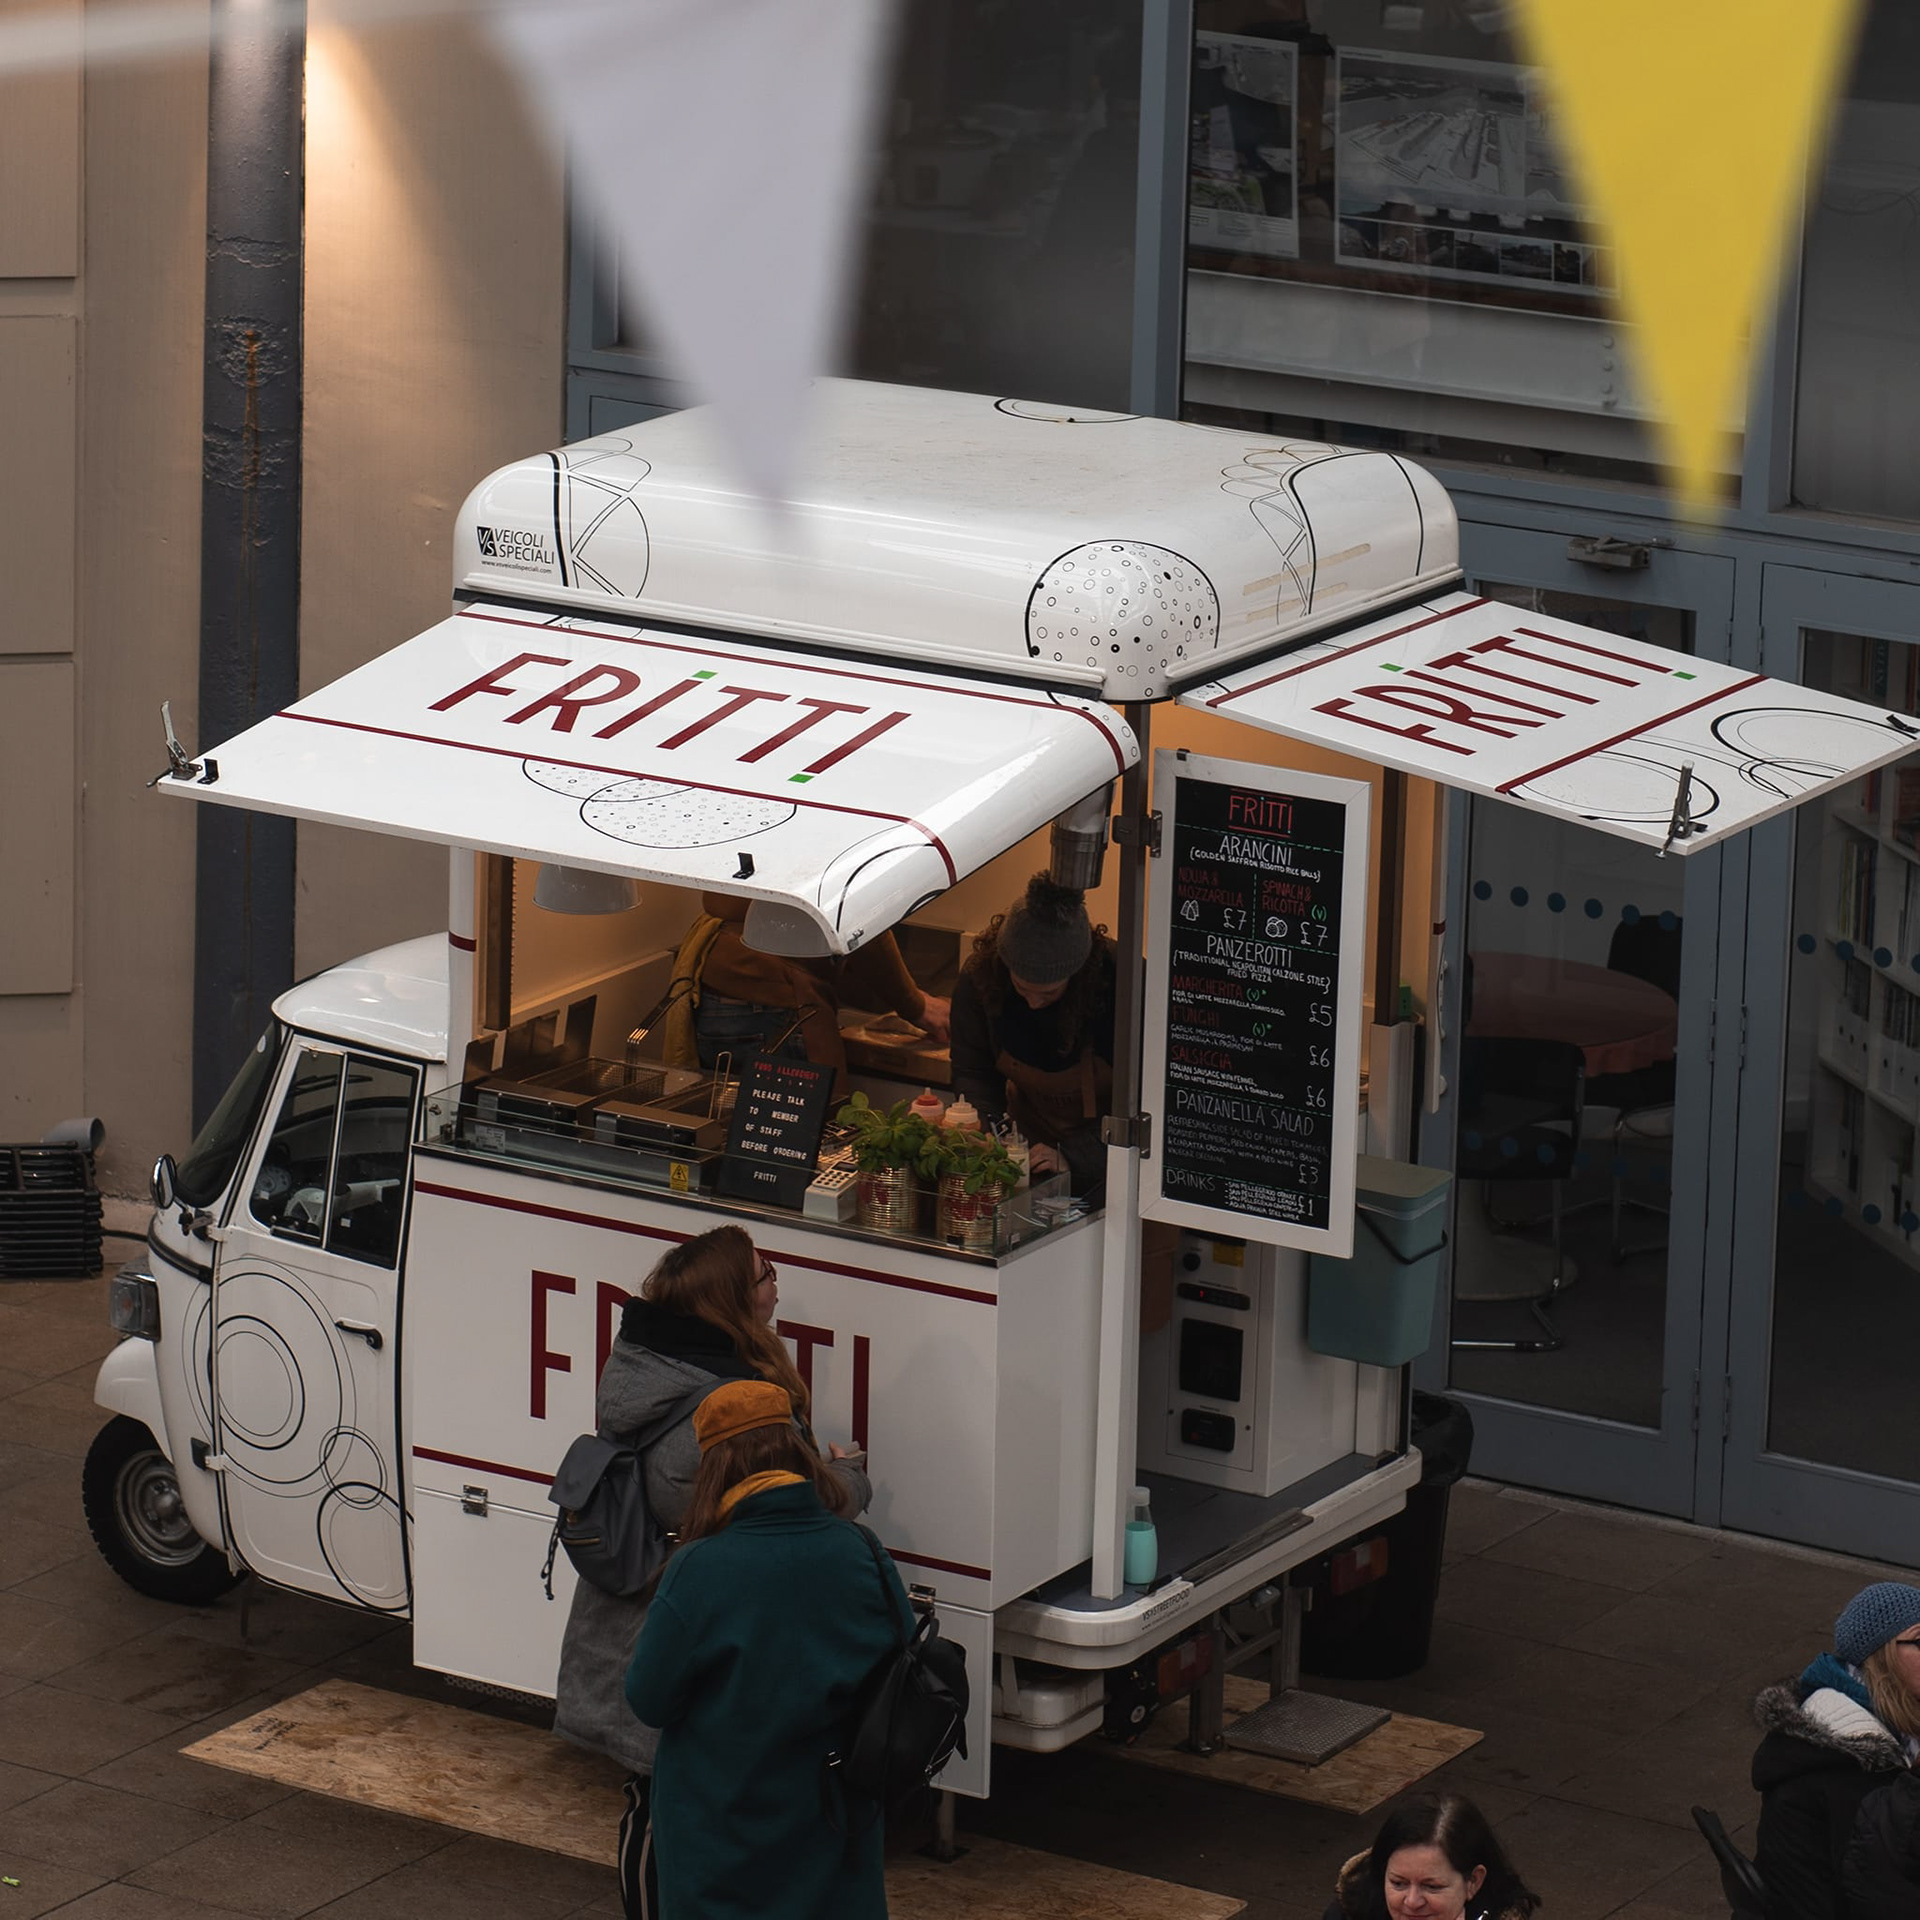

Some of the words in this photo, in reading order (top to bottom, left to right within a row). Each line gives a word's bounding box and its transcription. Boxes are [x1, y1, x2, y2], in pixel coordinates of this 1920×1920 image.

[495, 529, 544, 548] VEICOLI
[499, 544, 554, 565] SPECIALI
[1219, 833, 1291, 865] ARANCINI
[1228, 855, 1258, 867] SAFFRON
[1285, 866, 1299, 875] RICE
[1177, 883, 1244, 905] MOZZARELLA
[1262, 878, 1303, 900] SPINACH
[1261, 893, 1305, 915] RICOTTA
[1222, 906, 1246, 930] £7
[1299, 920, 1328, 948] £7
[1206, 934, 1291, 968] PANZEROTTI
[1227, 968, 1246, 978] FRIED
[1251, 972, 1271, 983] PIZZA
[1231, 960, 1270, 976] NEAPOLITAN
[1272, 968, 1304, 982] CALZONE
[1173, 974, 1243, 999] MARGHERITA
[1172, 1005, 1219, 1028] FUNGHI
[1309, 1002, 1333, 1027] £5
[1170, 1043, 1232, 1071] SALSICCIA
[1309, 1045, 1331, 1068] £6
[752, 1089, 782, 1102] PLEASE
[787, 1095, 806, 1107] TALK
[1306, 1086, 1327, 1107] £6
[750, 1106, 759, 1116] TO
[772, 1110, 799, 1124] MEMBER
[1176, 1089, 1265, 1126] PANZANELLA
[1270, 1108, 1313, 1137] SALAD
[745, 1123, 754, 1132] OF
[760, 1125, 783, 1138] STAFF
[741, 1140, 768, 1153] BEFORE
[773, 1146, 807, 1161] ORDERING
[754, 1171, 777, 1184] FRITTI
[1166, 1169, 1215, 1193] DRINKS
[1298, 1163, 1319, 1186] £3
